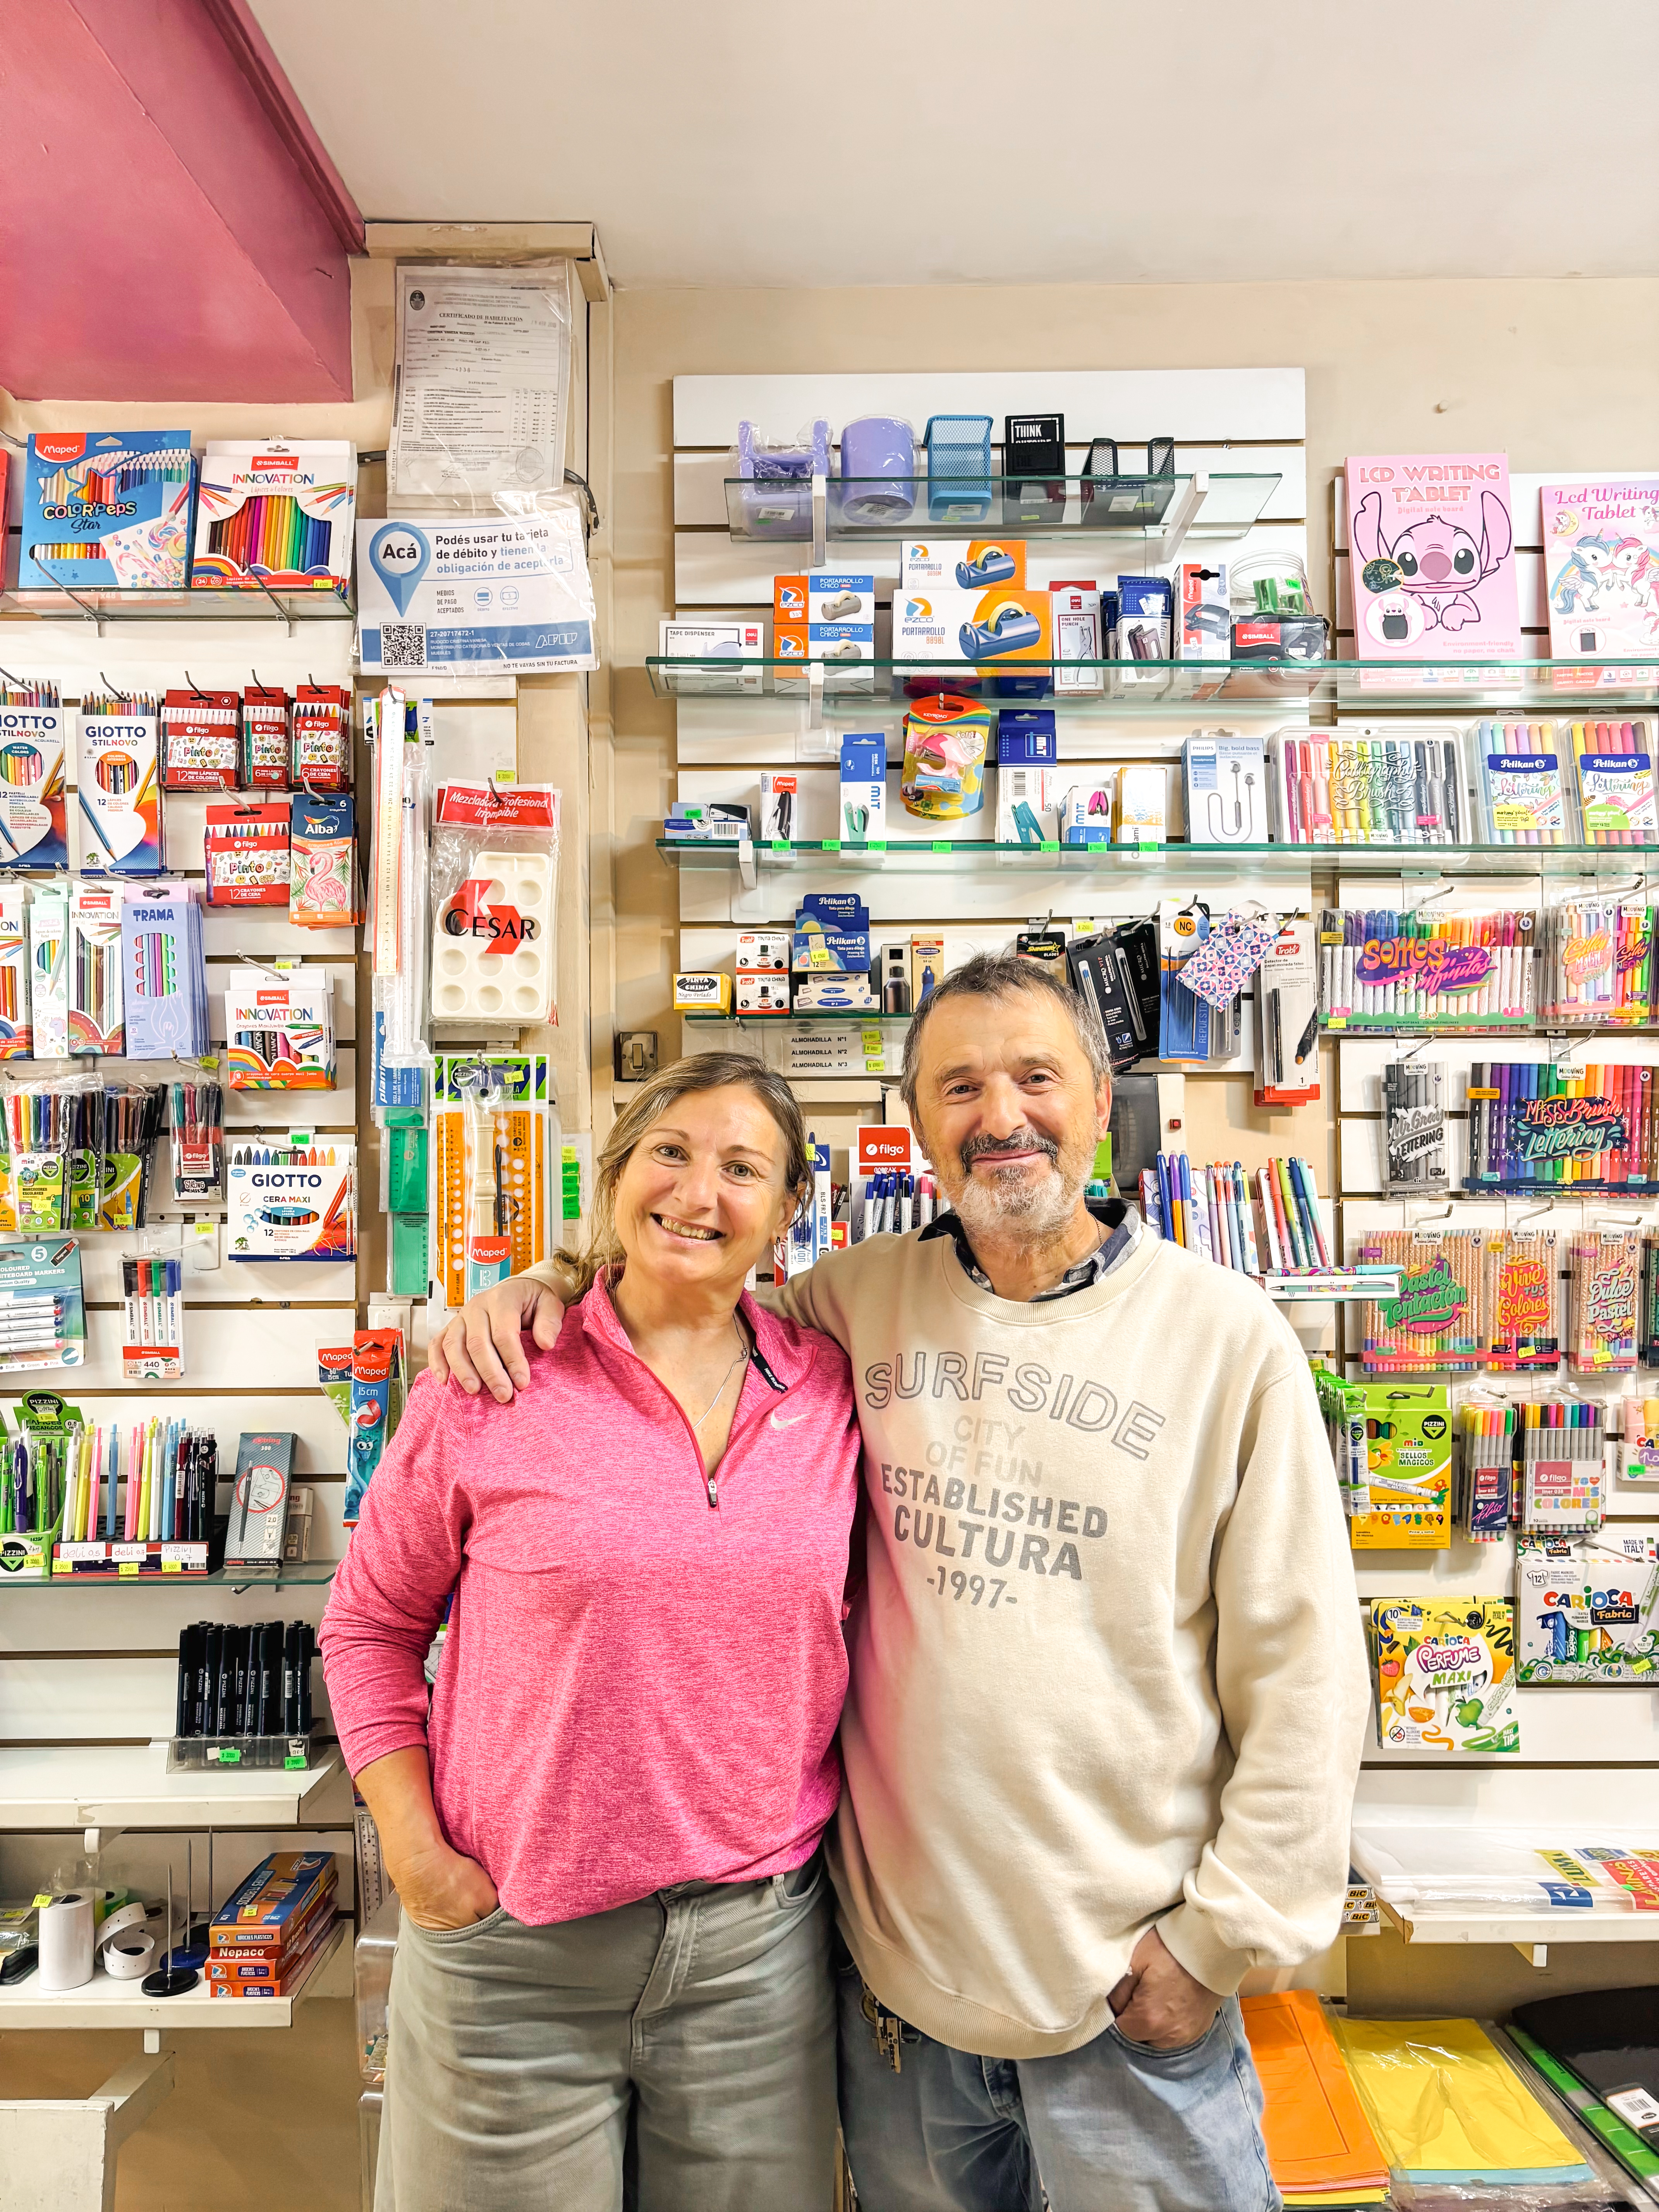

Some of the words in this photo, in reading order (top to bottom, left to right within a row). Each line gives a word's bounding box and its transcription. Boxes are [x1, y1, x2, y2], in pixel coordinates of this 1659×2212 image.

[1015, 425, 1041, 438] THINK
[43, 445, 78, 454] Maped
[232, 474, 314, 484] INNOVATION
[1360, 467, 1394, 483] LCD
[1401, 464, 1500, 481] WRITING
[1392, 486, 1471, 502] TABLET
[1555, 488, 1587, 504] Lcd
[1591, 488, 1659, 503] Writing
[1582, 505, 1636, 520] Tablet
[71, 518, 101, 534] Star
[436, 535, 470, 544] Podés
[474, 534, 498, 543] usar
[502, 533, 512, 542] tu
[383, 543, 417, 559] Acá
[436, 551, 450, 559] de
[453, 548, 487, 559] débito
[491, 550, 497, 559] y
[500, 547, 533, 556] tienen
[437, 562, 493, 574] obligación
[498, 561, 511, 570] de
[902, 627, 945, 635] PORTARROLLO
[536, 633, 577, 648] AFIP
[86, 726, 146, 737] GIOTTO
[1501, 759, 1534, 768] Pelikan
[1593, 759, 1626, 768] Pelikan
[1333, 759, 1417, 783] Calligraphy
[1346, 781, 1393, 800] Brush
[1495, 778, 1555, 796] Lettering
[475, 807, 519, 818] Irrompible
[305, 824, 334, 834] Alba
[133, 909, 174, 921] TRAMA
[445, 908, 535, 940] CESAR
[1180, 922, 1191, 931] NC
[1278, 945, 1296, 954] Trabi
[1615, 941, 1647, 963] Silky
[1617, 960, 1643, 969] NEON
[1415, 954, 1498, 994] infinitos
[236, 1008, 313, 1020] INNOVATION
[1565, 1095, 1623, 1125] Brush
[1396, 1127, 1443, 1161] LETTERING
[1521, 1122, 1613, 1162] Lettering
[879, 1144, 903, 1156] filgo
[252, 1174, 321, 1187] GIOTTO
[35, 1249, 43, 1259] 5
[472, 1247, 505, 1256] Maped
[1502, 1263, 1547, 1297] Vive
[1524, 1286, 1544, 1296] TUS
[1587, 1278, 1633, 1307] Dulce
[1379, 1283, 1467, 1328] Tentación
[1498, 1296, 1549, 1326] Colores
[1587, 1302, 1632, 1324] Pastel
[355, 1366, 386, 1375] Maped
[865, 1351, 1165, 1460] SURFSIDE
[954, 1415, 1025, 1449] CITY
[925, 1441, 966, 1469] OF
[975, 1451, 1042, 1487] FUN
[1573, 1487, 1599, 1496] MIS
[881, 1463, 1108, 1538] ESTABLISHED
[1534, 1498, 1599, 1508] COLORES
[895, 1505, 1082, 1580] CULTURA
[927, 1566, 1017, 1608] -1997-
[1597, 1610, 1632, 1619] Fabric
[1433, 1671, 1472, 1685] MAXI
[1503, 1734, 1514, 1746] TIP
[220, 1948, 264, 1958] Nepaco
